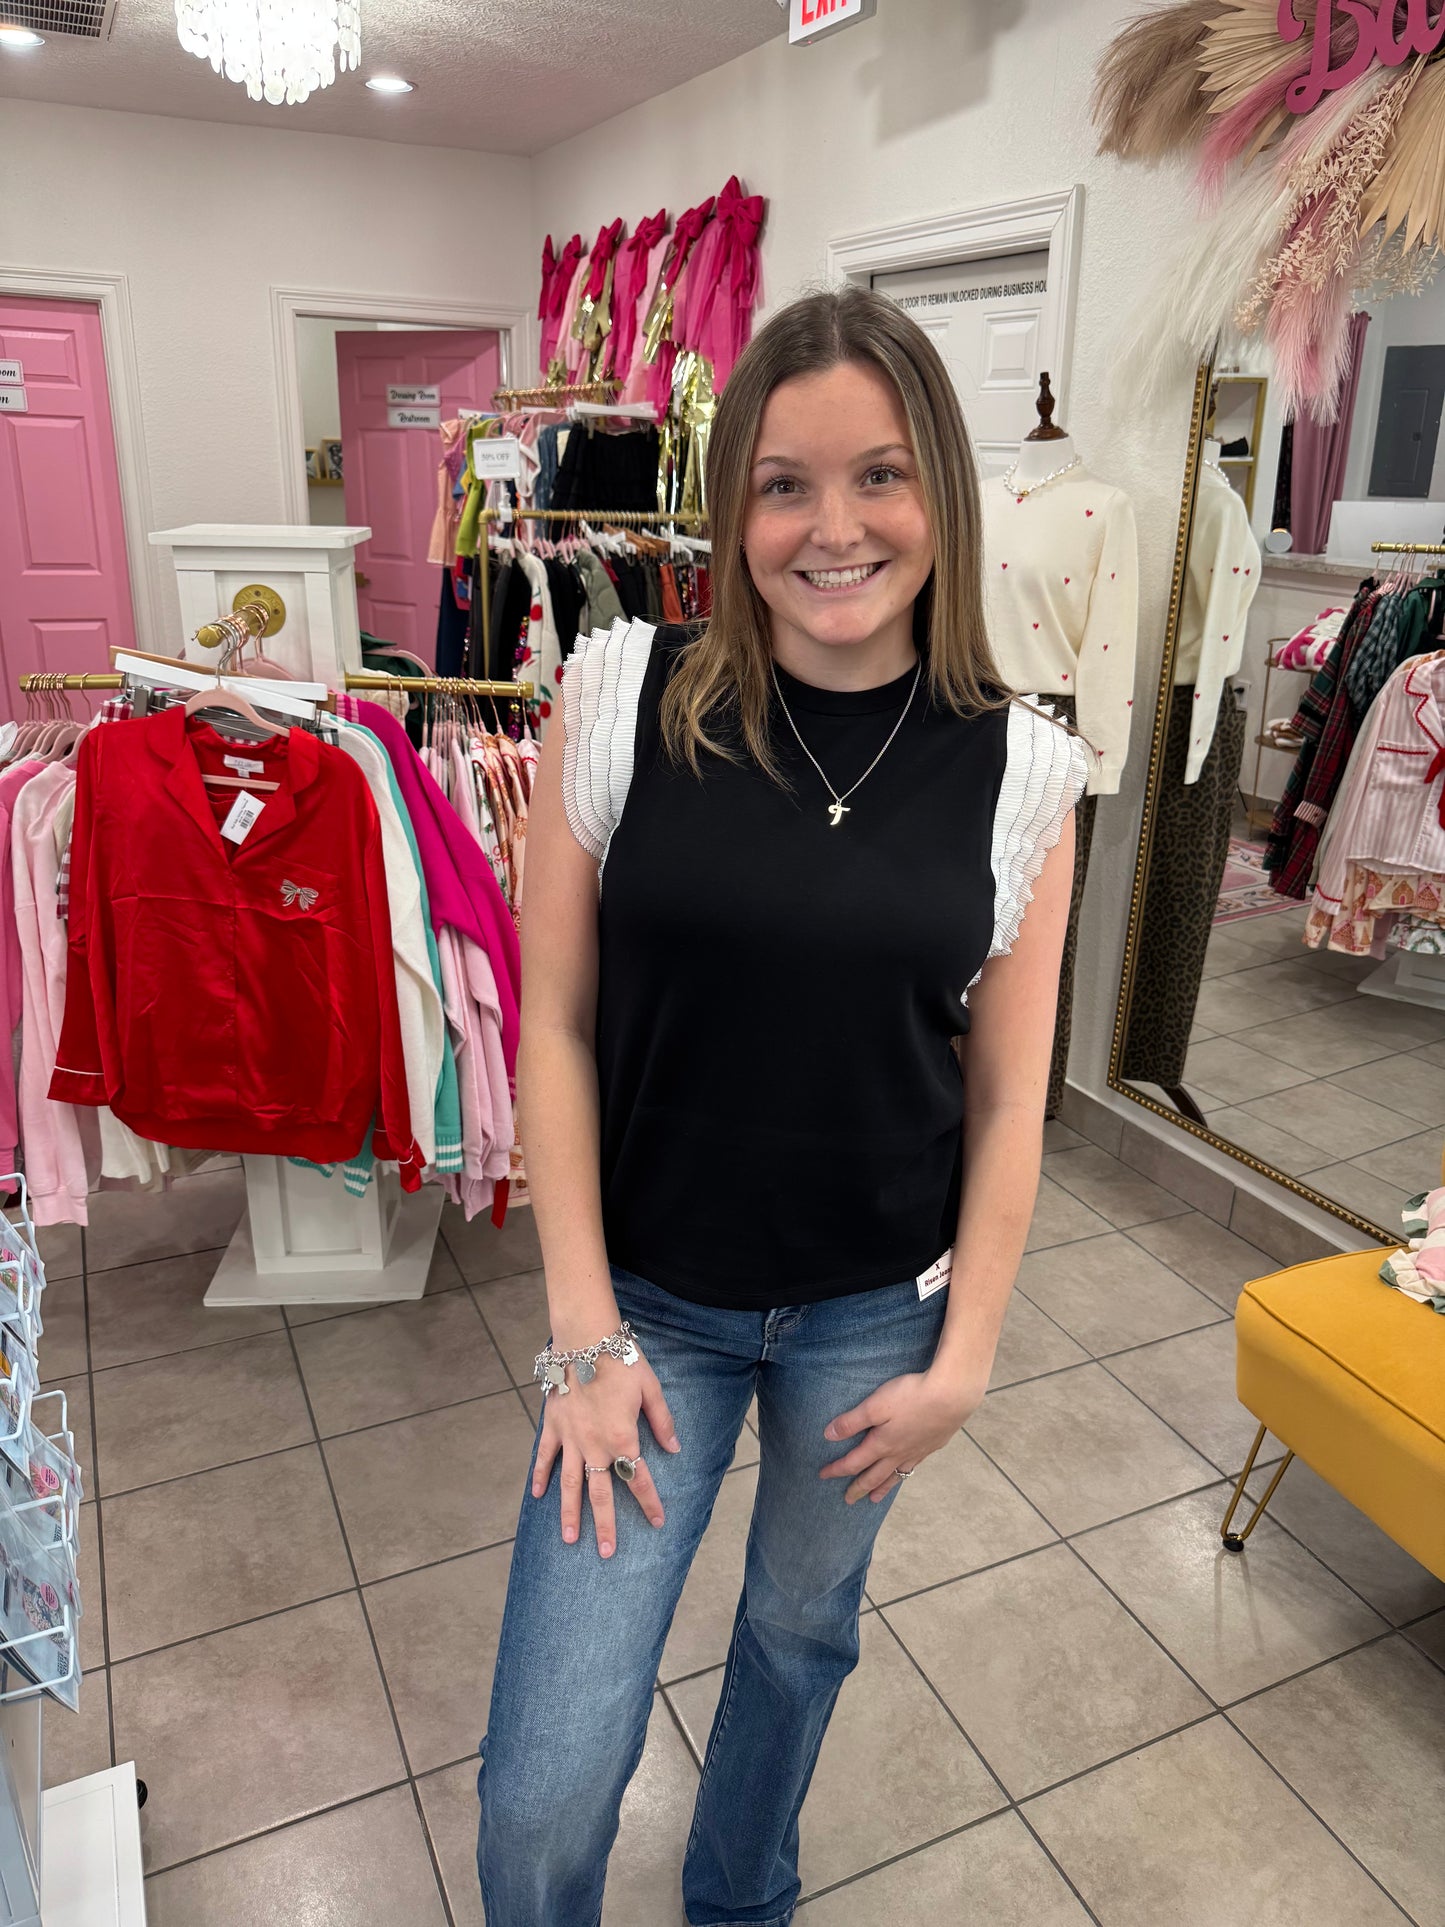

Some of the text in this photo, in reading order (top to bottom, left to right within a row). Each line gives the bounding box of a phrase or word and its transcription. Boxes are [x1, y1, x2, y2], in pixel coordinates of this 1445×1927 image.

[905, 296, 919, 309] DOOR
[920, 295, 927, 307] TO
[928, 293, 948, 306] REMAIN
[949, 288, 979, 304] UNLOCKED
[980, 285, 1002, 300] DURING
[1003, 281, 1033, 297] BUSINESS
